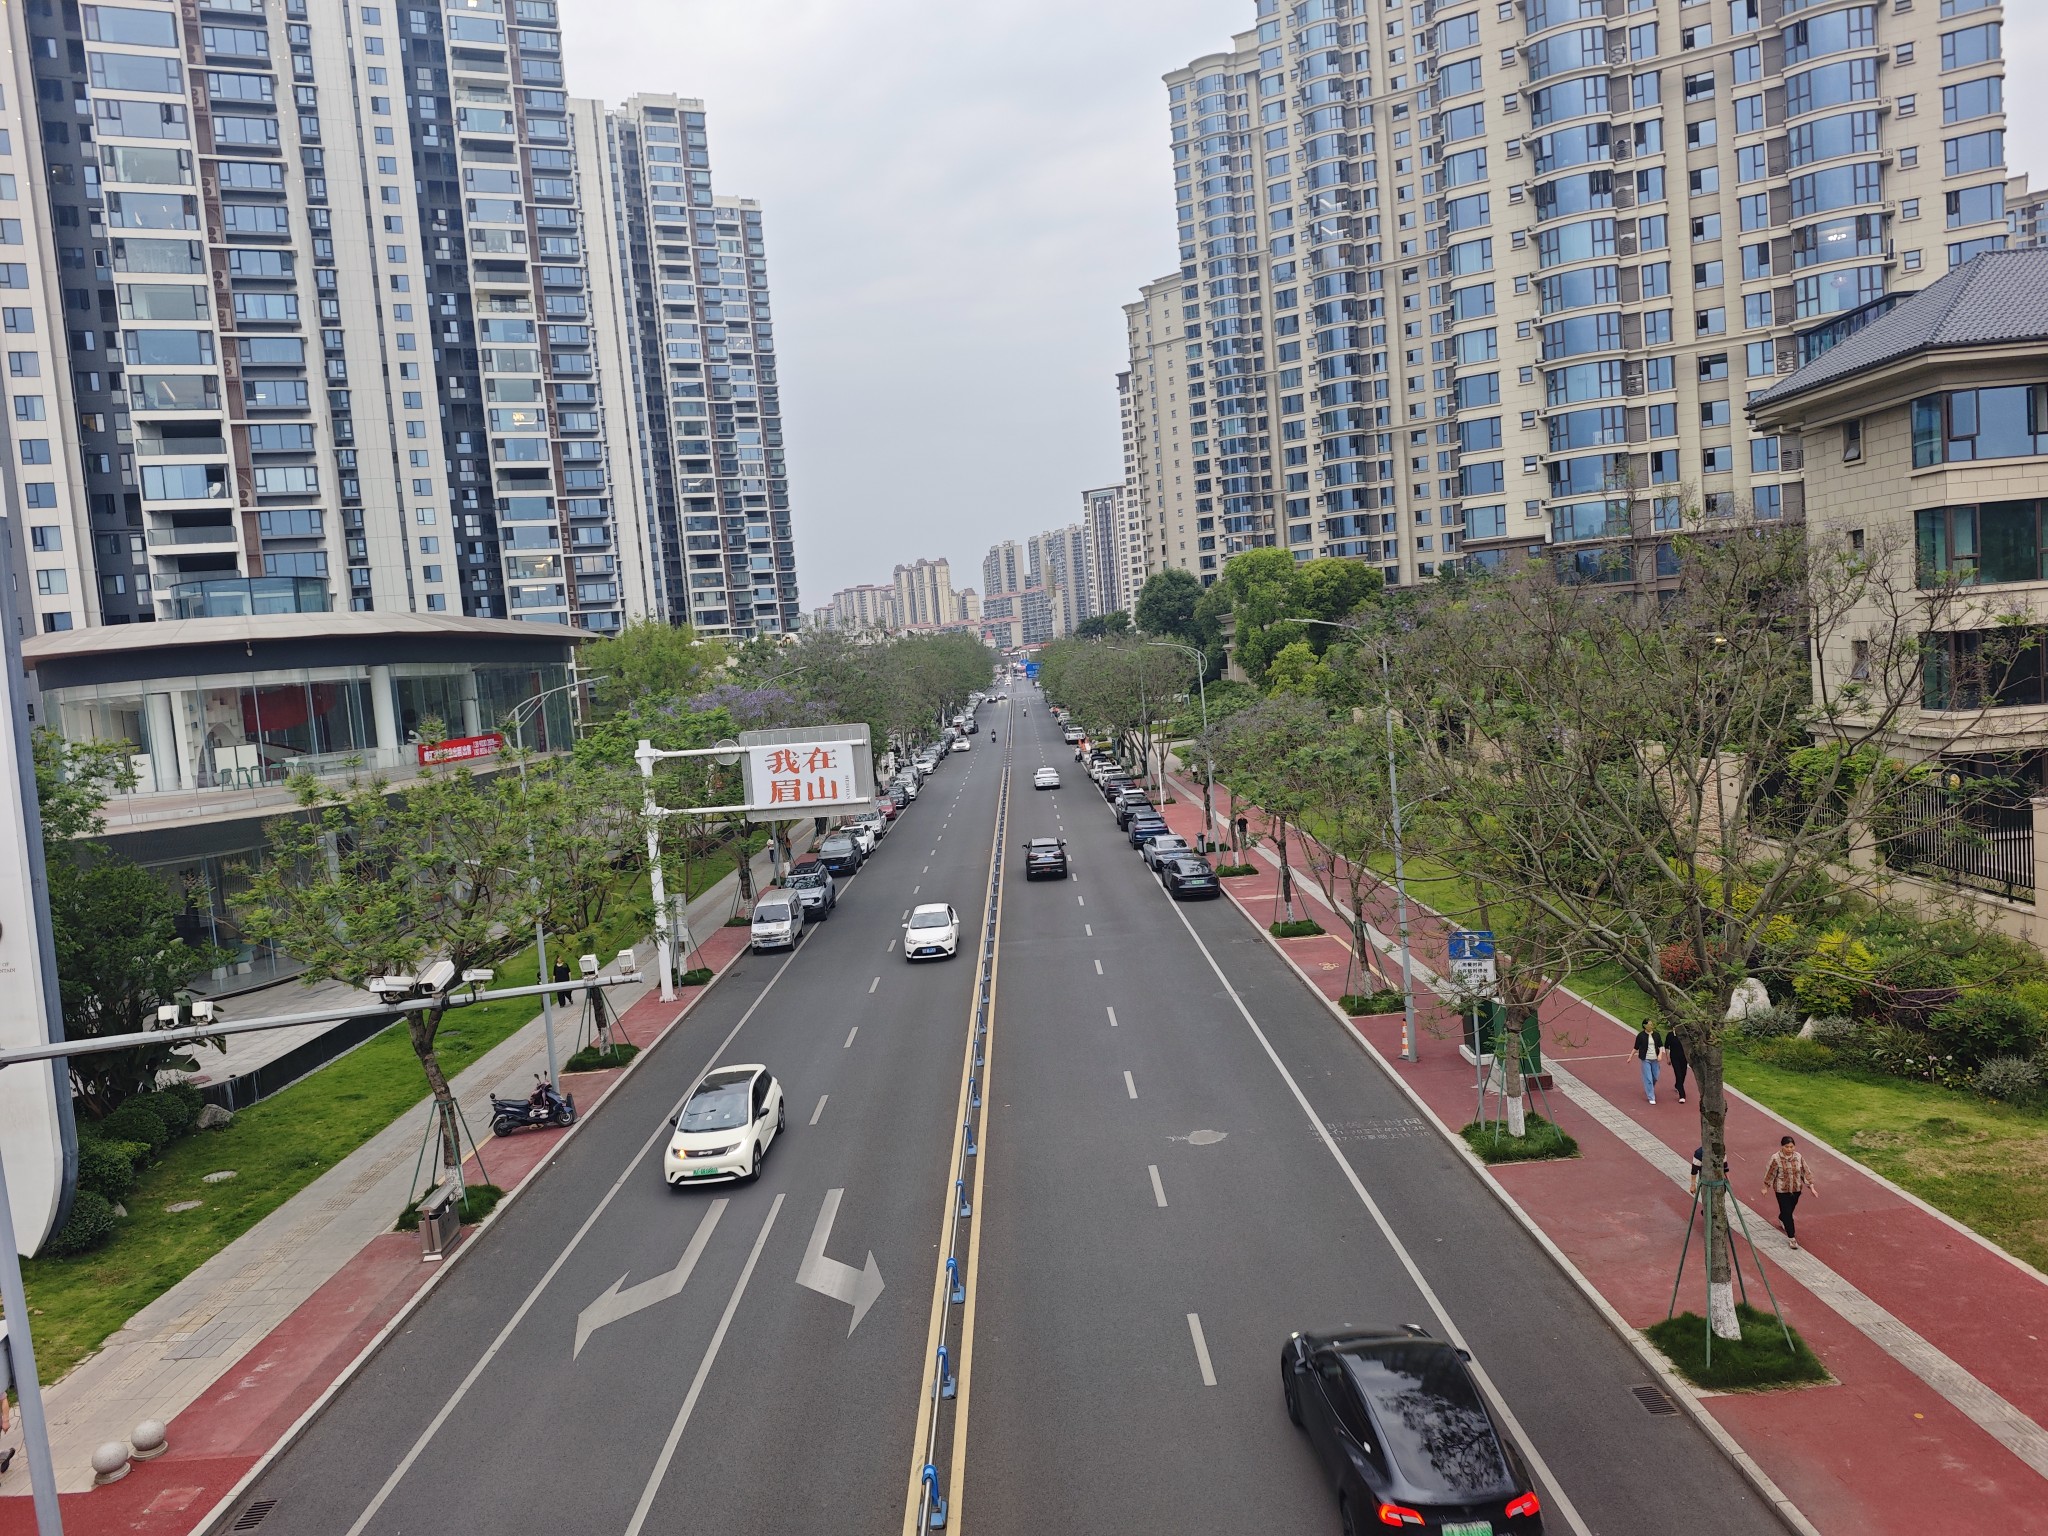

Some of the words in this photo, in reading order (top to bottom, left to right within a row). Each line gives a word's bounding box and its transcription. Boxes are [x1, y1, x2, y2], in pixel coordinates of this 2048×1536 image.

[764, 746, 838, 774] 我在
[769, 776, 838, 804] 眉山
[1462, 934, 1480, 957] P
